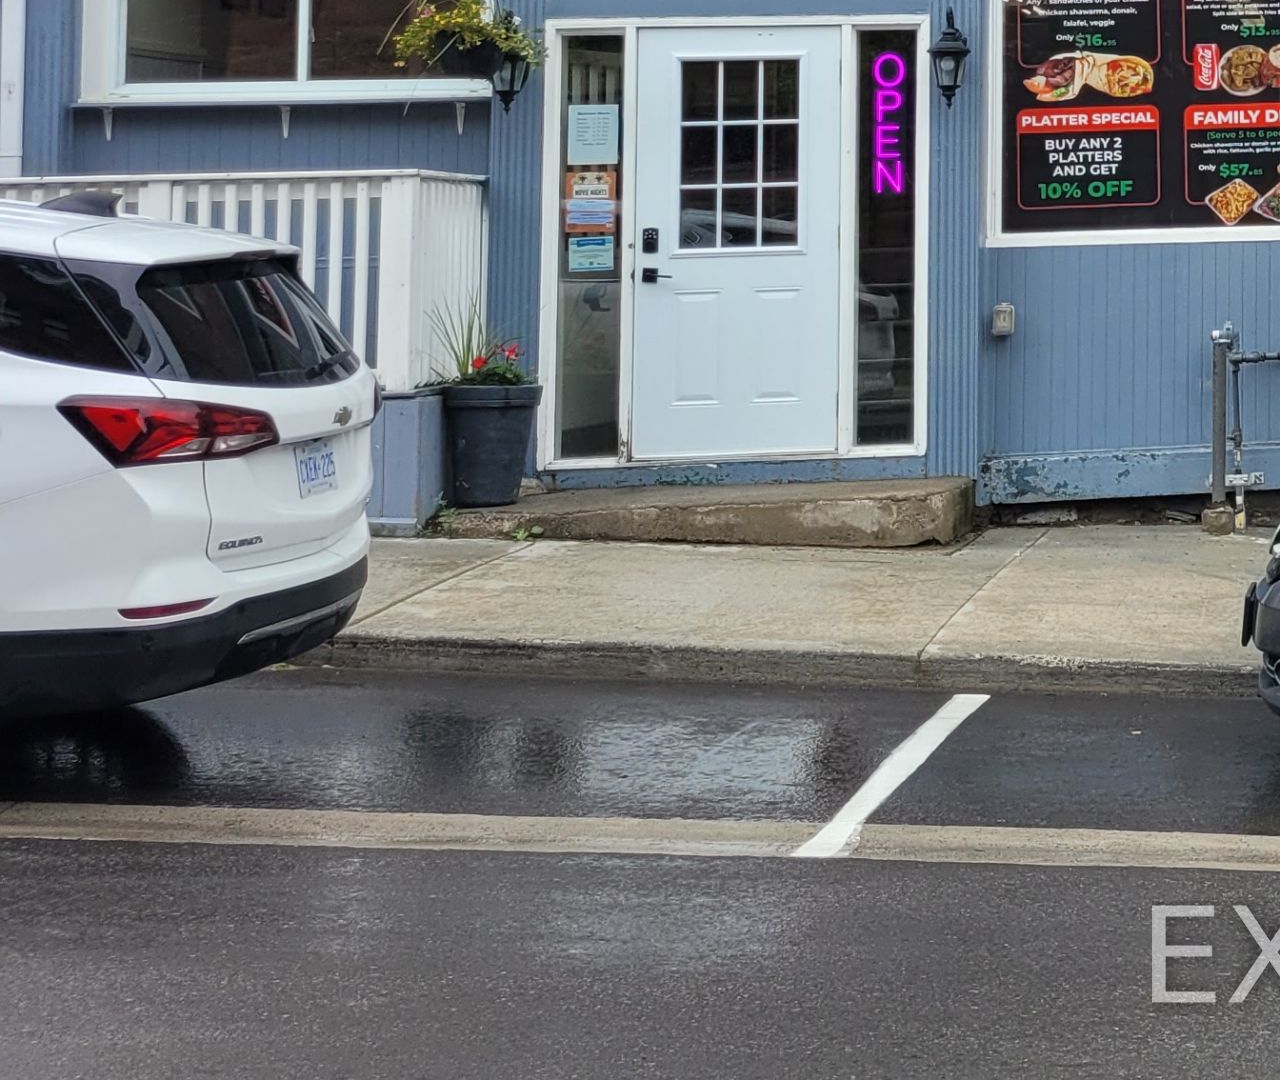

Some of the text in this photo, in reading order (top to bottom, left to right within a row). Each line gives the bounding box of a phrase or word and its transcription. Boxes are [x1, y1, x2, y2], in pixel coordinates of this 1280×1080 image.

[1026, 0, 1042, 7] Any
[1089, 19, 1115, 28] veggie
[1221, 23, 1239, 32] Only
[1056, 34, 1074, 42] Only
[873, 51, 905, 195] OPEN
[1021, 112, 1156, 127] PLATTER SPECIAL
[1193, 109, 1260, 125] FAMILY
[1207, 130, 1236, 140] (Serve
[1246, 130, 1256, 138] to
[1045, 137, 1122, 151] BUY ANY 2
[1049, 150, 1122, 163] PLATTERS
[1052, 163, 1118, 177] AND GET
[1198, 163, 1216, 172] Only
[1038, 180, 1133, 199] 10% OFF
